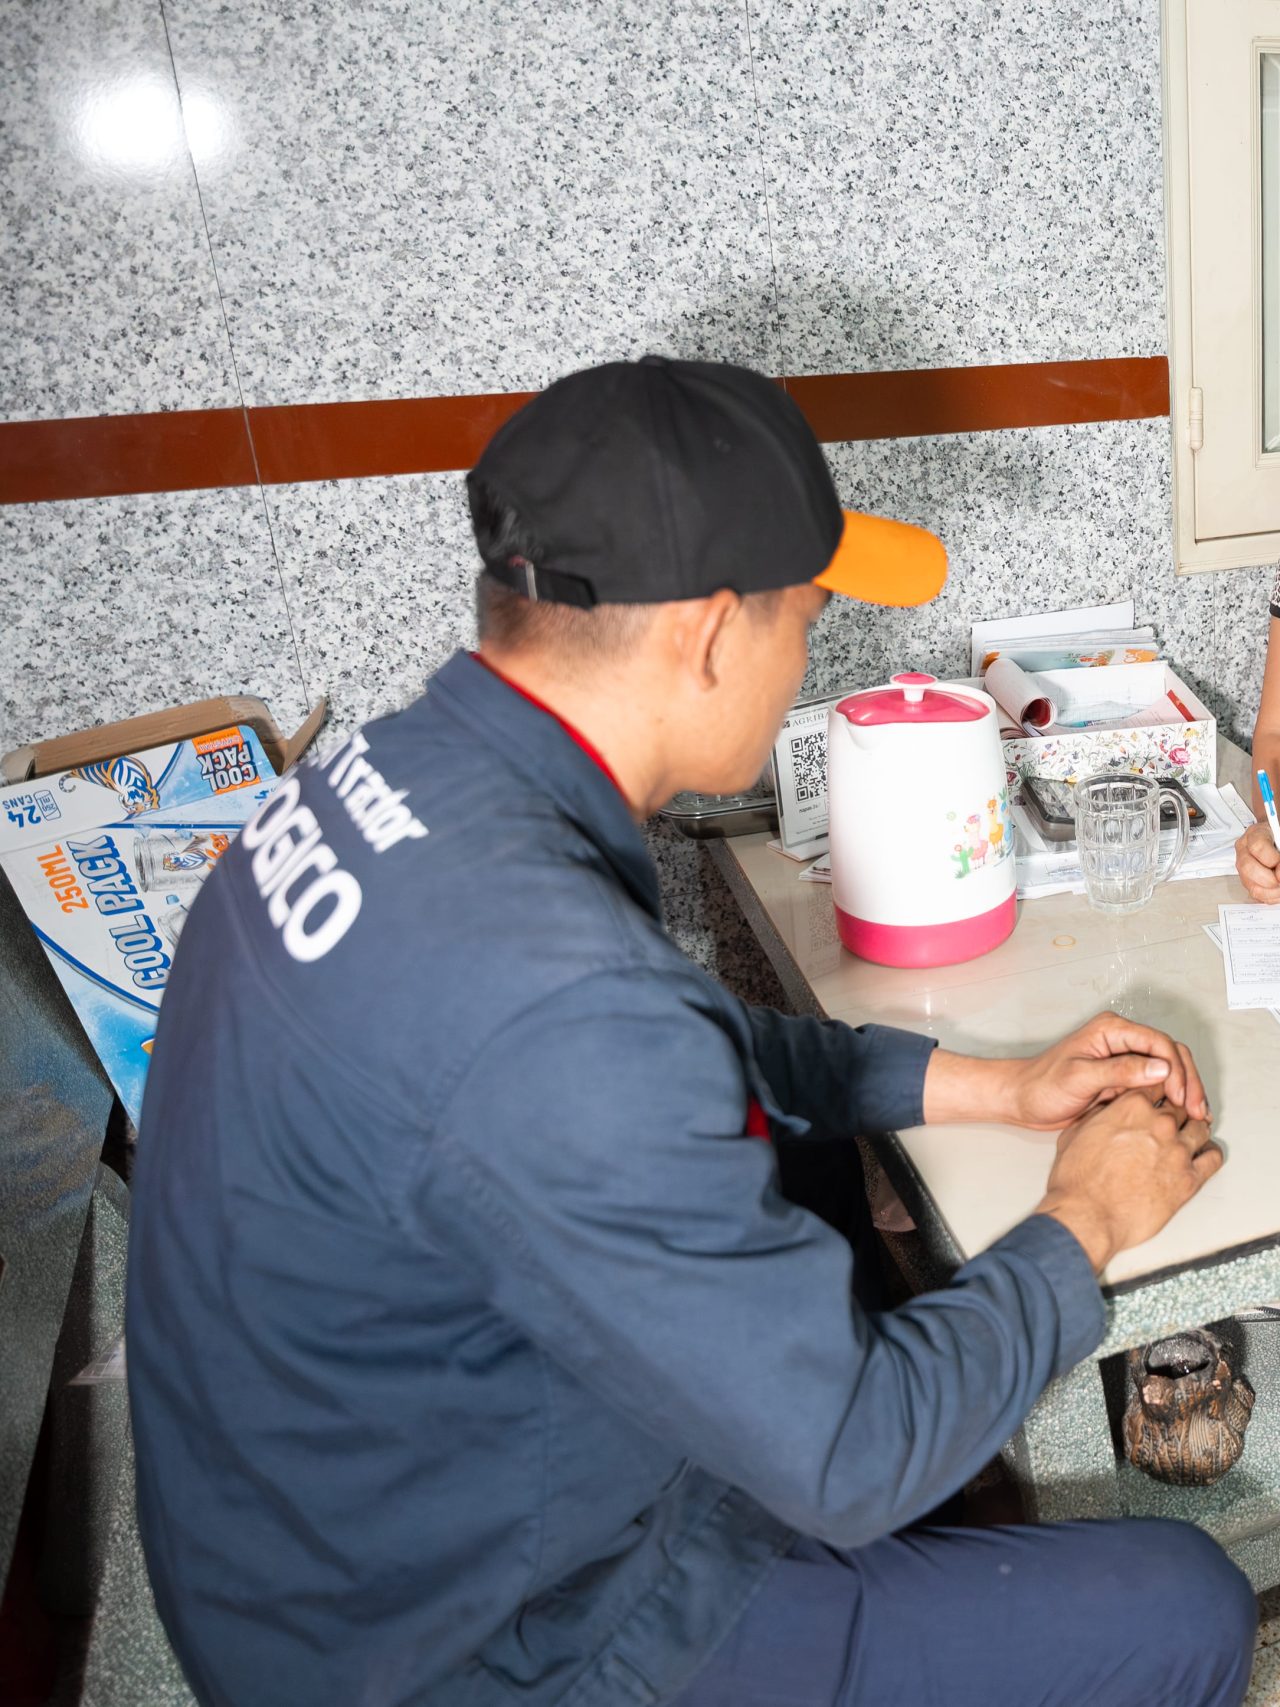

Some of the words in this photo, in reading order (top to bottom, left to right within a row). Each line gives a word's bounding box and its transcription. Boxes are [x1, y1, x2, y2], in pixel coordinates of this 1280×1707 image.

[196, 740, 252, 776] PACK
[202, 764, 259, 793] COOL
[4, 793, 34, 810] CANS
[8, 804, 42, 828] 24
[36, 844, 90, 914] 250ML
[66, 834, 145, 916] PACK
[241, 768, 363, 963] OGICO
[109, 913, 171, 990] COOL
